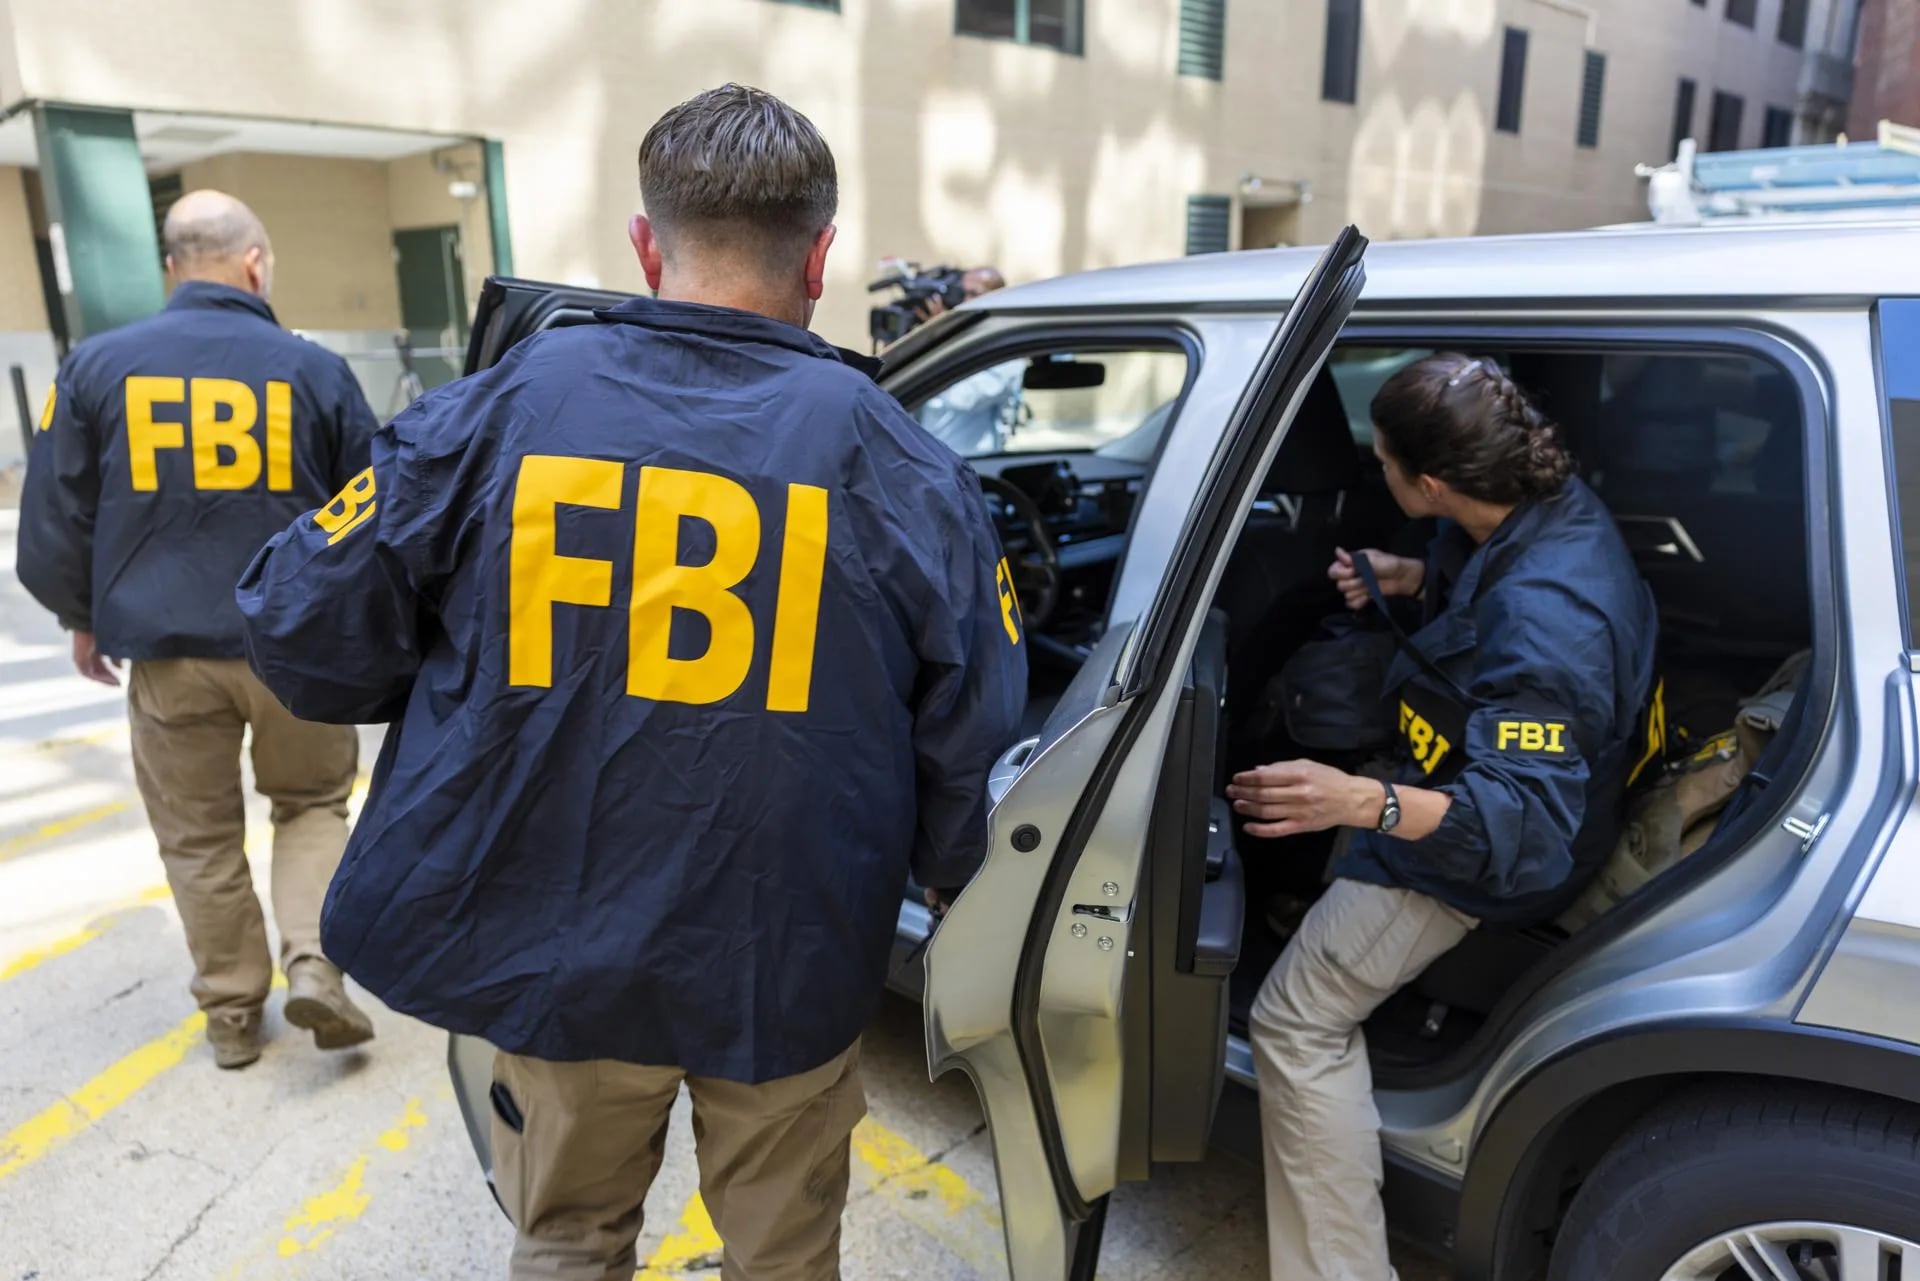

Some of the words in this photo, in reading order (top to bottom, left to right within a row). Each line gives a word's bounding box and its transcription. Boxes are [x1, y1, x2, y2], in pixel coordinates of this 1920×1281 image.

[125, 376, 293, 492] FBI
[313, 465, 377, 546] BI
[509, 455, 828, 712] FBI
[1498, 721, 1565, 752] FBI
